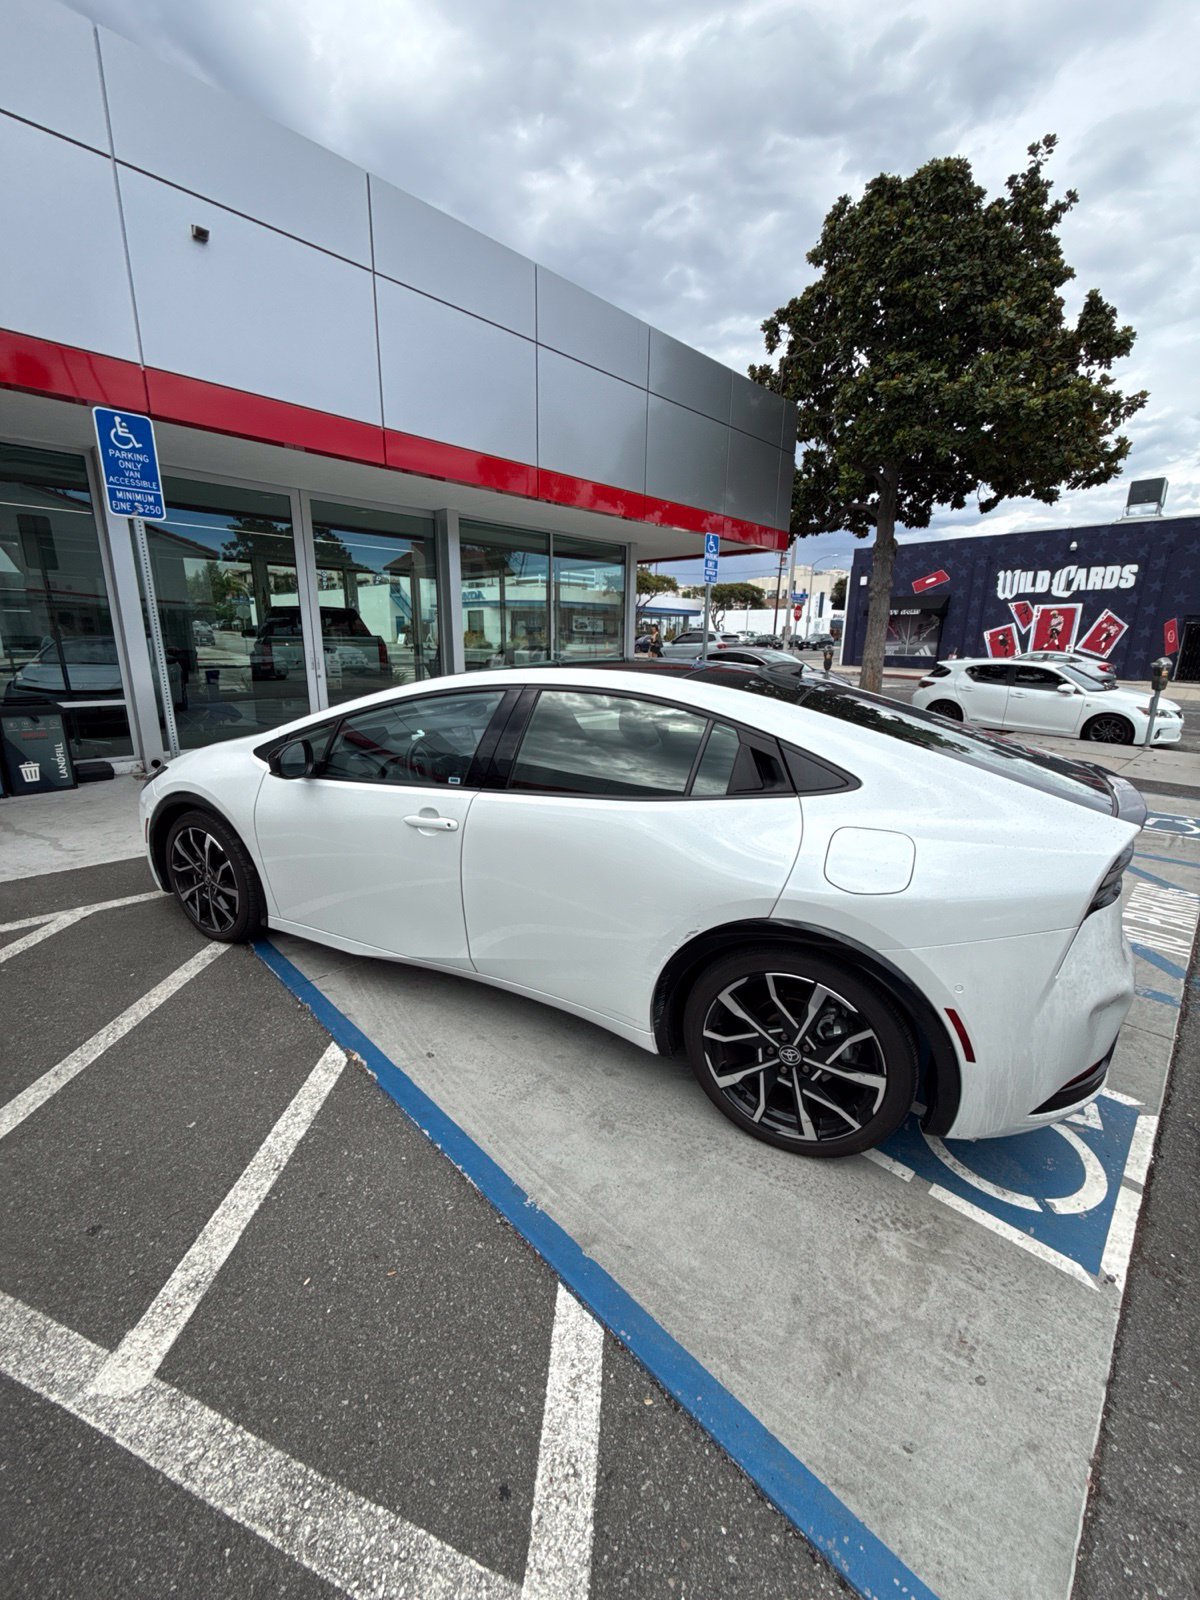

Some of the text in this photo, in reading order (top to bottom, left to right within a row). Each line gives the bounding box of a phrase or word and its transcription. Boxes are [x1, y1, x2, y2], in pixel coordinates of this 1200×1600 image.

[108, 449, 149, 463] PARKING
[118, 460, 141, 470] ONLY
[124, 470, 140, 478] VAN
[109, 476, 158, 489] ACCESSIBLE
[115, 490, 155, 503] MINIMUM
[997, 564, 1139, 600] WILD CARDS
[51, 742, 69, 779] LANDFILL
